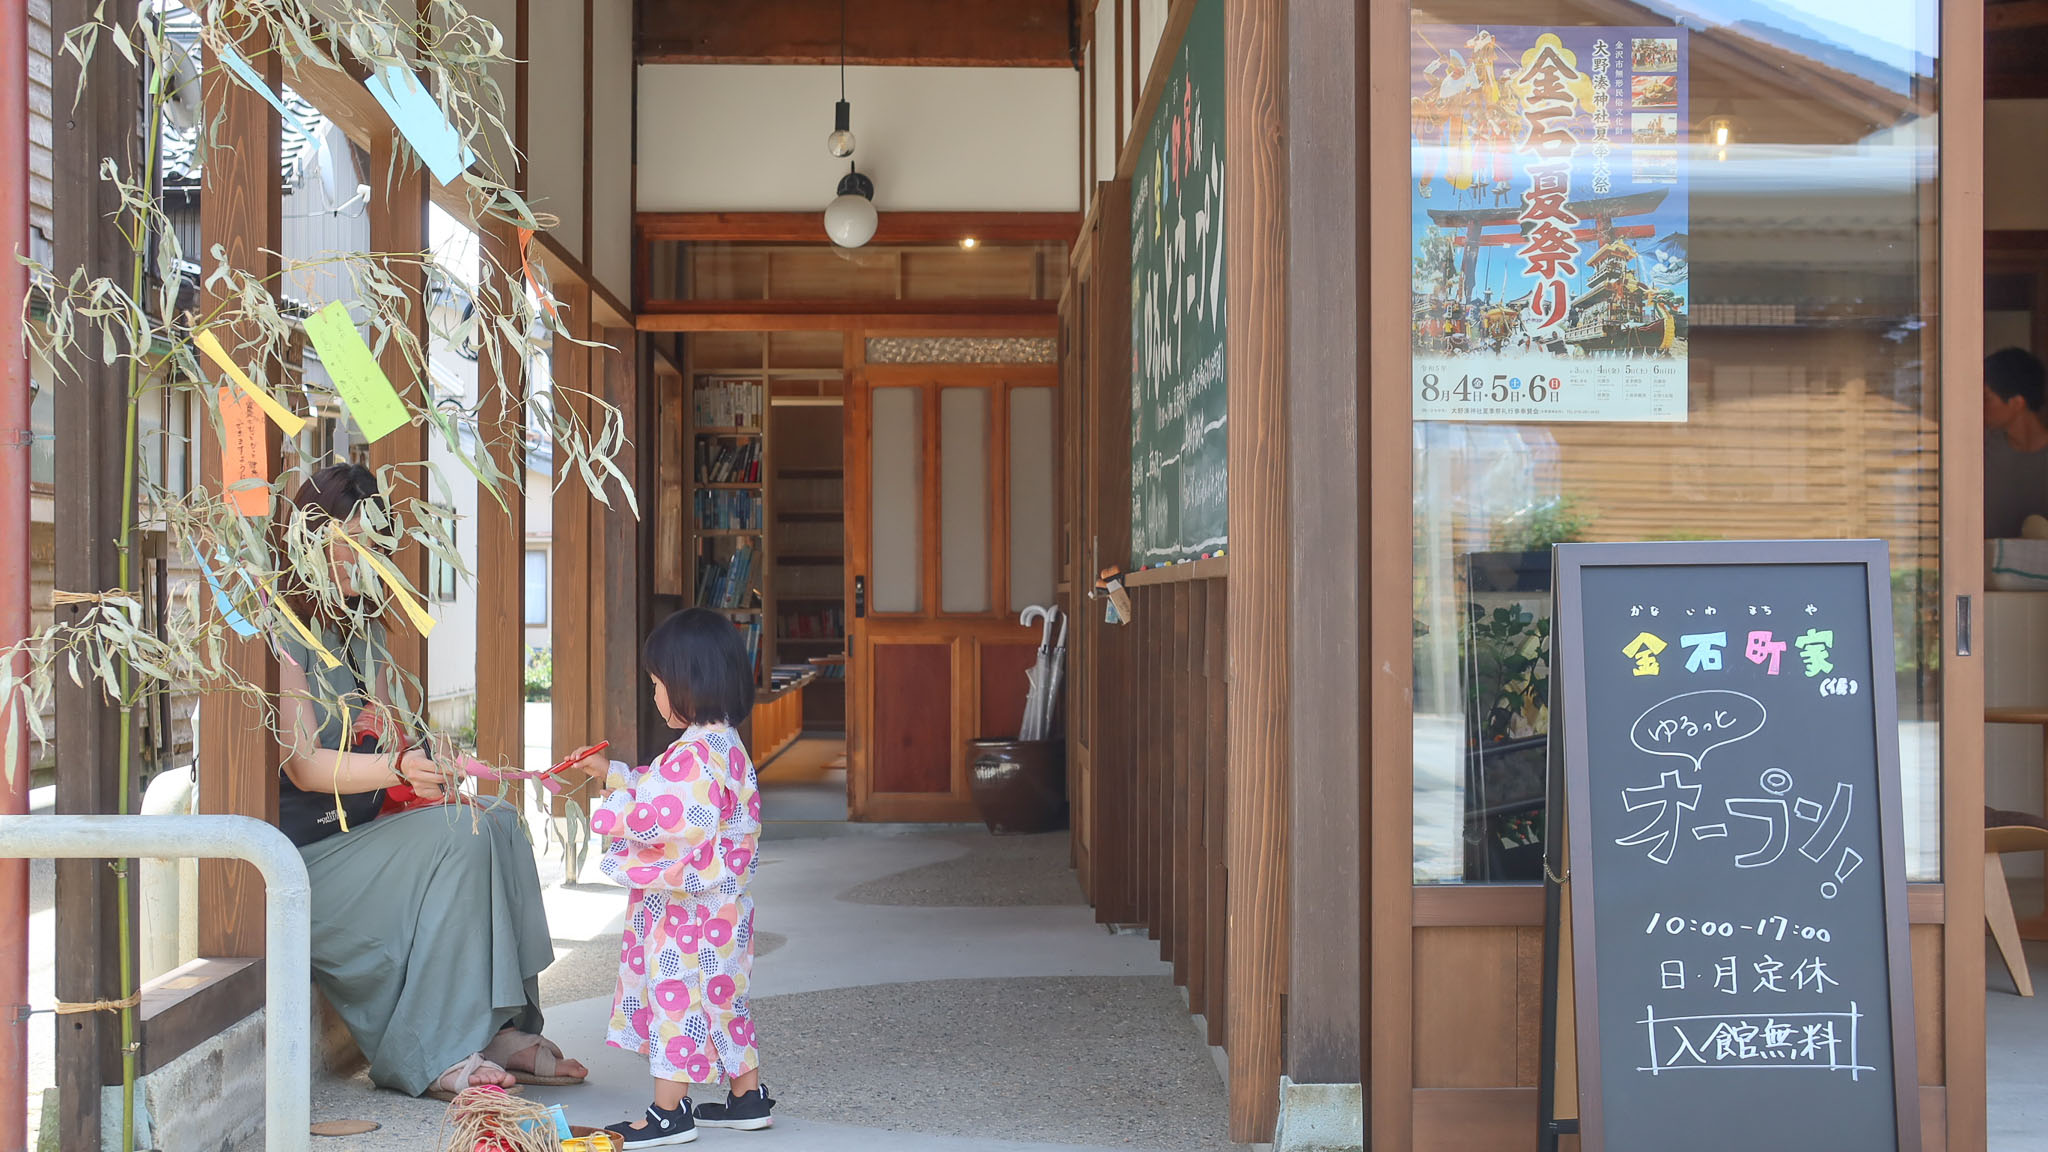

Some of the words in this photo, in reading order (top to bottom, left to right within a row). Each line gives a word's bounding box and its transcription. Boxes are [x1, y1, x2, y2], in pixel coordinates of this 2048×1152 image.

[1614, 39, 1625, 136] 金沢市無形民俗文化財
[1519, 45, 1580, 331] 金石夏祭り
[1144, 141, 1227, 401] ゆるっとオープン
[1622, 628, 1834, 677] 金石町家
[1648, 710, 1737, 743] ゆるっと
[1661, 954, 1840, 994] 日・月定休
[1666, 1018, 1842, 1071] 入館無料
